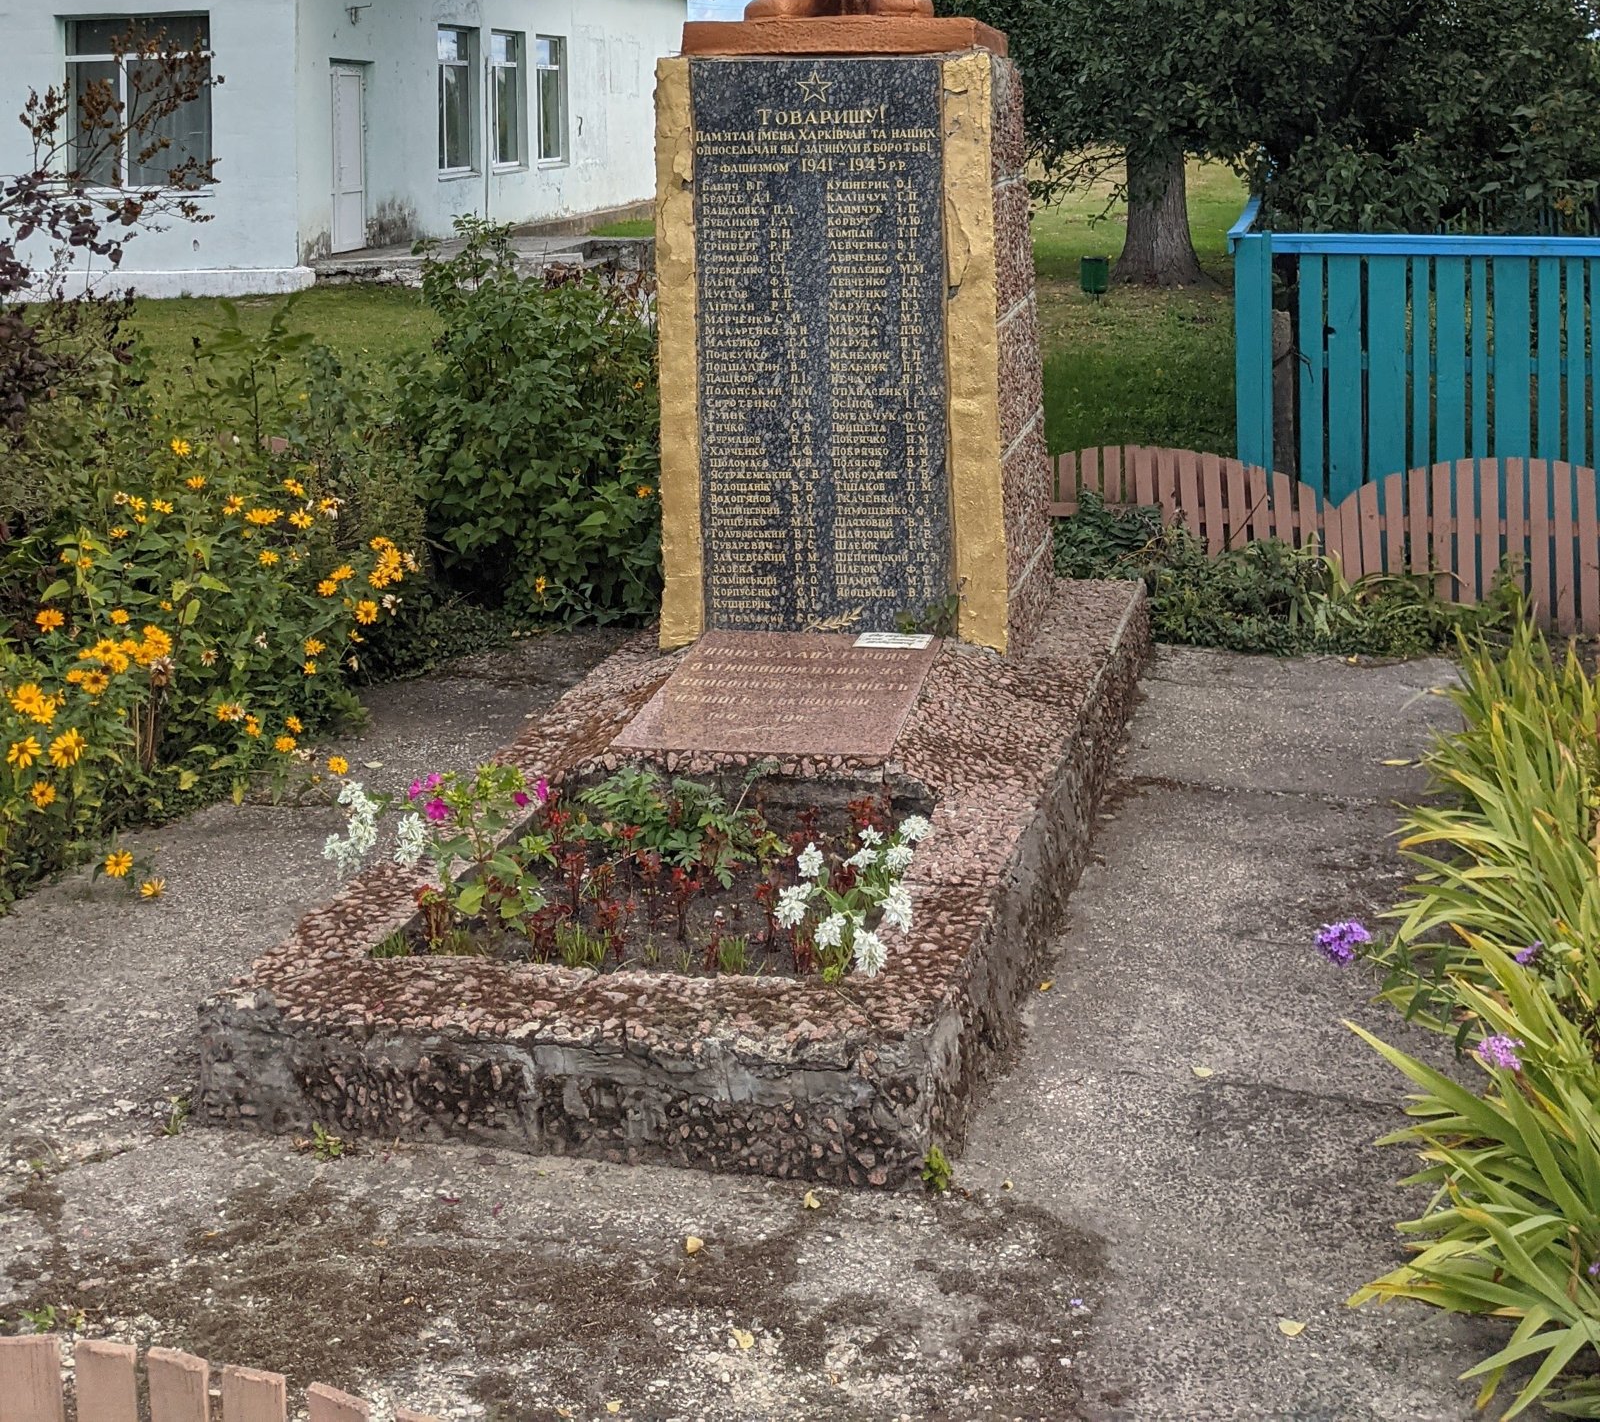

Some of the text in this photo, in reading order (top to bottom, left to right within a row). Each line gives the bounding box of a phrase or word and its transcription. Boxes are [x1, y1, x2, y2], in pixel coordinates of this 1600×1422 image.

[757, 104, 885, 125] ТОВАРИШУ!
[798, 127, 866, 140] ХАРКІВЧАН
[871, 129, 886, 139] ТА
[892, 128, 936, 138] НАШИХ
[696, 141, 931, 155] ОДНОСЕЛЬЧАН ЯКІ ЗАГИНУЛИ В БОРОТЬБІ
[712, 164, 718, 173] З
[720, 163, 789, 173] ФАШИЗМОМ
[801, 157, 833, 172] 1941
[849, 157, 886, 171] 1945
[828, 241, 888, 250] ЛЕВЧЕНКО
[828, 253, 888, 262] ЛЕВЧЕНКО
[829, 277, 886, 286] ЛЕВЧЕНКО
[829, 289, 888, 298] ЛЕВЧЕНКО
